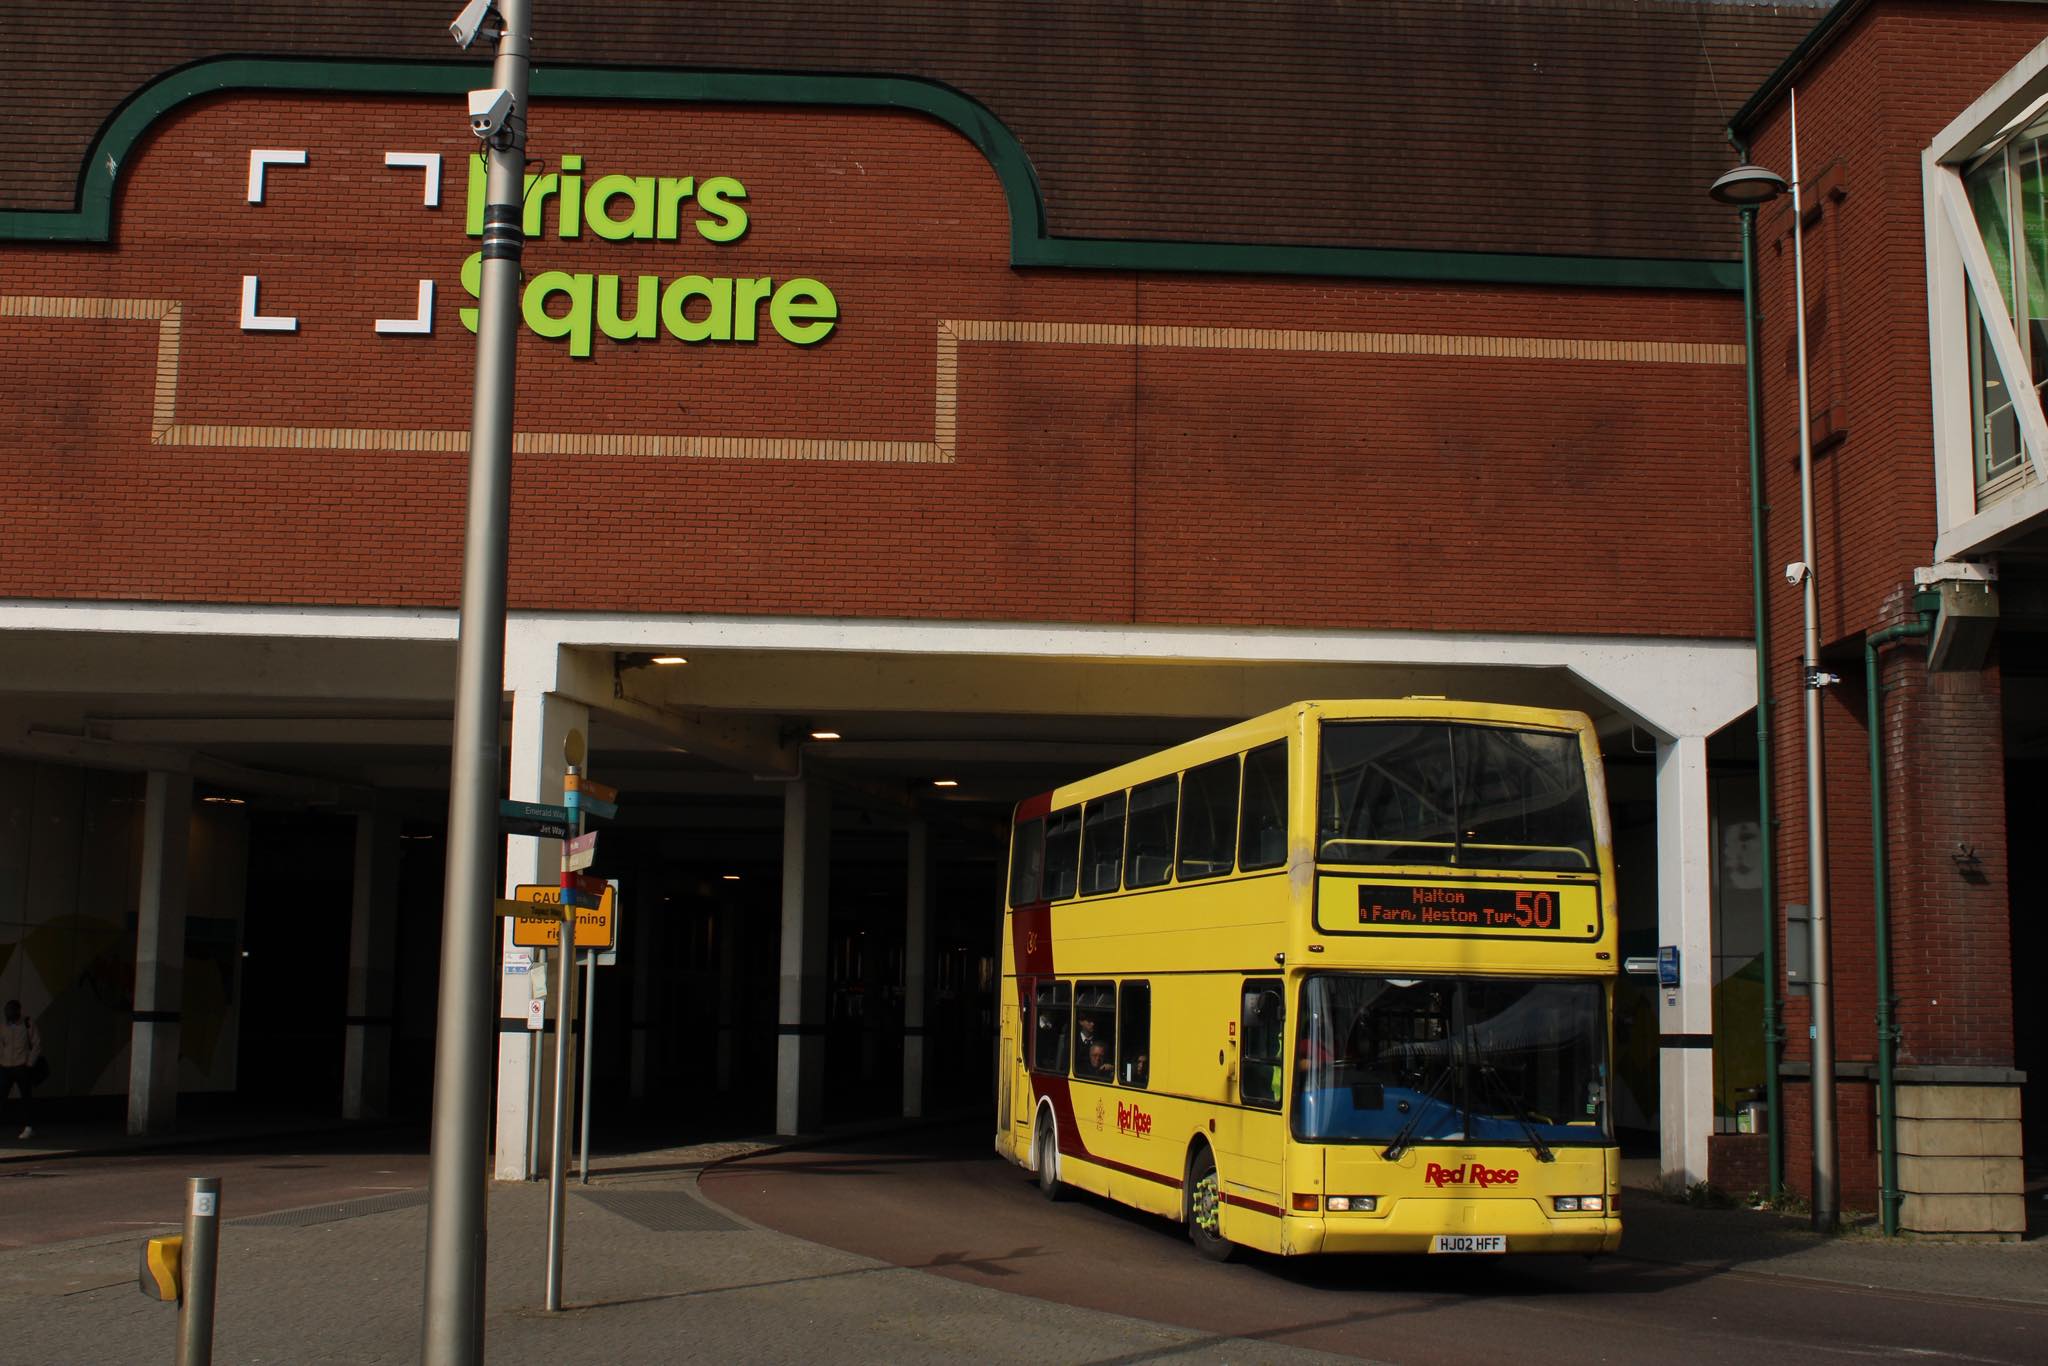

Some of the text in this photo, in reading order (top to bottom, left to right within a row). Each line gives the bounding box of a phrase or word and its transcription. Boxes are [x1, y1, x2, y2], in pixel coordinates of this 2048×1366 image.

[525, 806, 566, 820] Emerald Way
[540, 824, 566, 837] Jet Way
[1412, 888, 1465, 905] Halton
[1372, 905, 1417, 922] Farm,
[1422, 907, 1478, 924] Weston
[1515, 891, 1553, 929] 50
[1117, 1100, 1133, 1134] Red
[1133, 1104, 1152, 1137] Rose
[1425, 1163, 1519, 1189] Red Rose
[1440, 1237, 1500, 1251] HJ02 HFF
